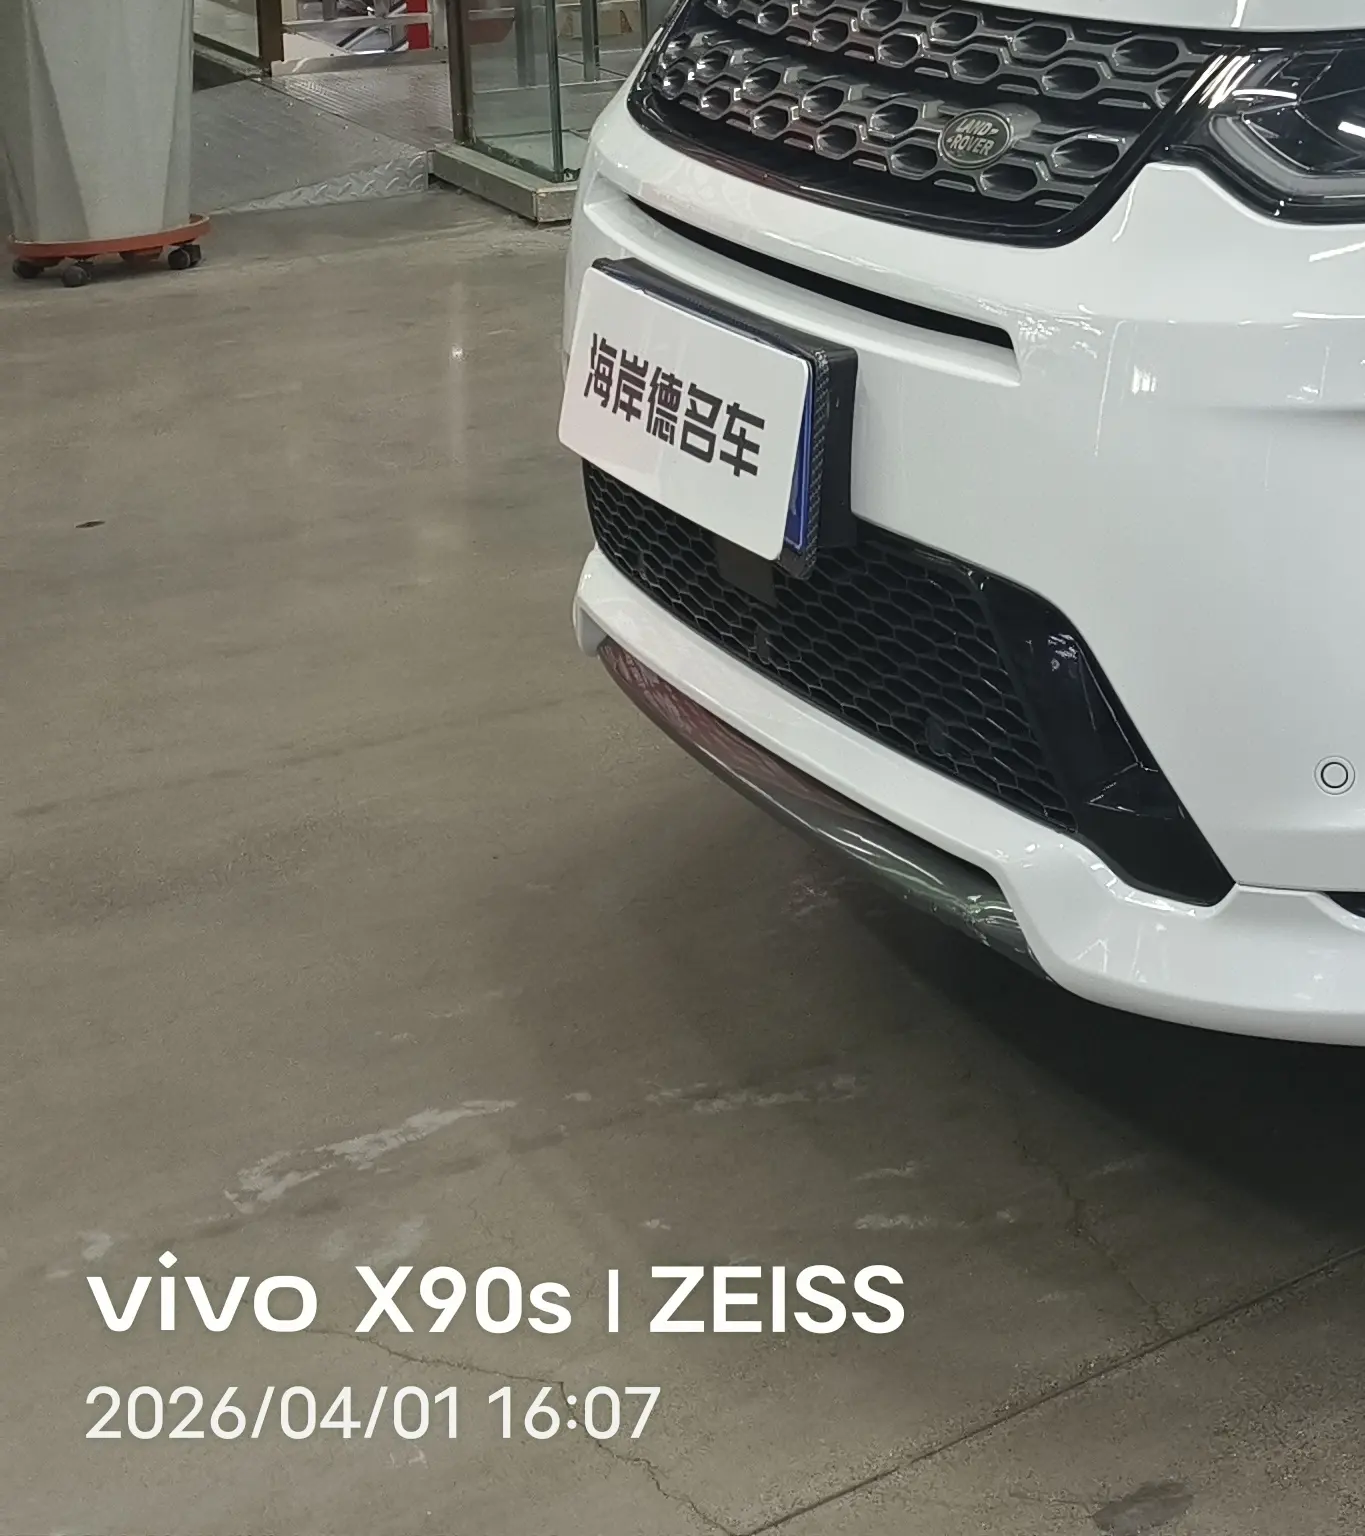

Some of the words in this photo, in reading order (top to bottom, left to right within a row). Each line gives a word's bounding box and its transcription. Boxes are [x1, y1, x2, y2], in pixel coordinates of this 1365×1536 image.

[955, 118, 993, 136] LAND
[949, 133, 995, 156] ROVER
[583, 332, 765, 478] 海岸德名车
